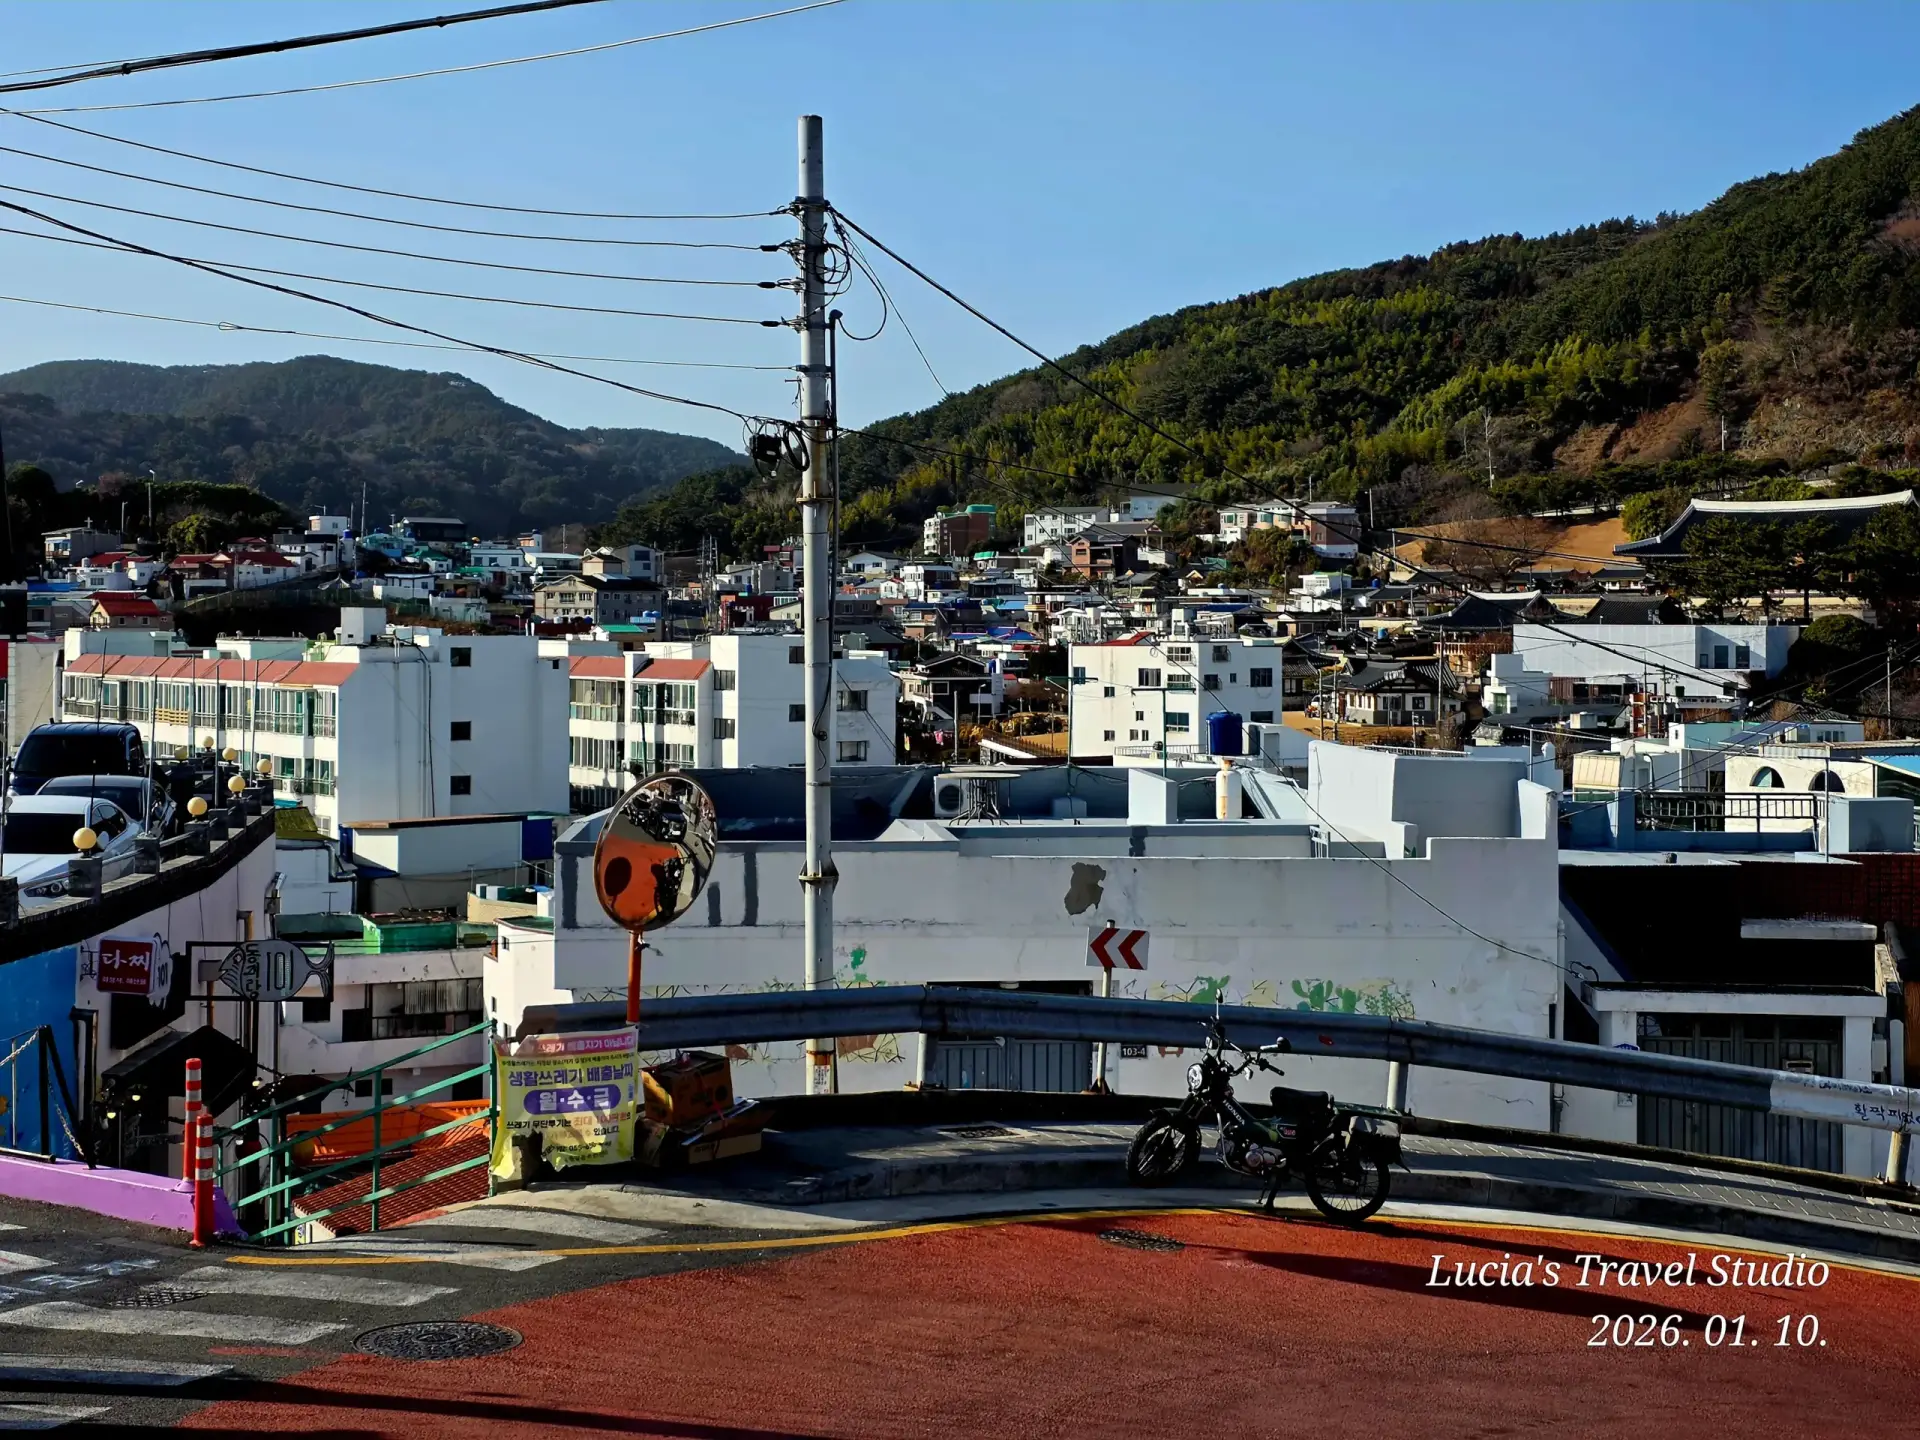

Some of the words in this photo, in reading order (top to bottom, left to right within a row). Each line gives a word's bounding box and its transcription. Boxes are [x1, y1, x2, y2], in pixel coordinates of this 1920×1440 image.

[101, 949, 150, 972] 다찌
[266, 949, 294, 992] 101
[1122, 1047, 1146, 1056] 103-4
[508, 1068, 583, 1087] 생활쓰레기
[586, 1063, 634, 1082] 배출날짜
[506, 1120, 531, 1129] 쓰레기
[532, 1119, 571, 1129] 무단투기는
[1222, 1098, 1246, 1127] HONDA
